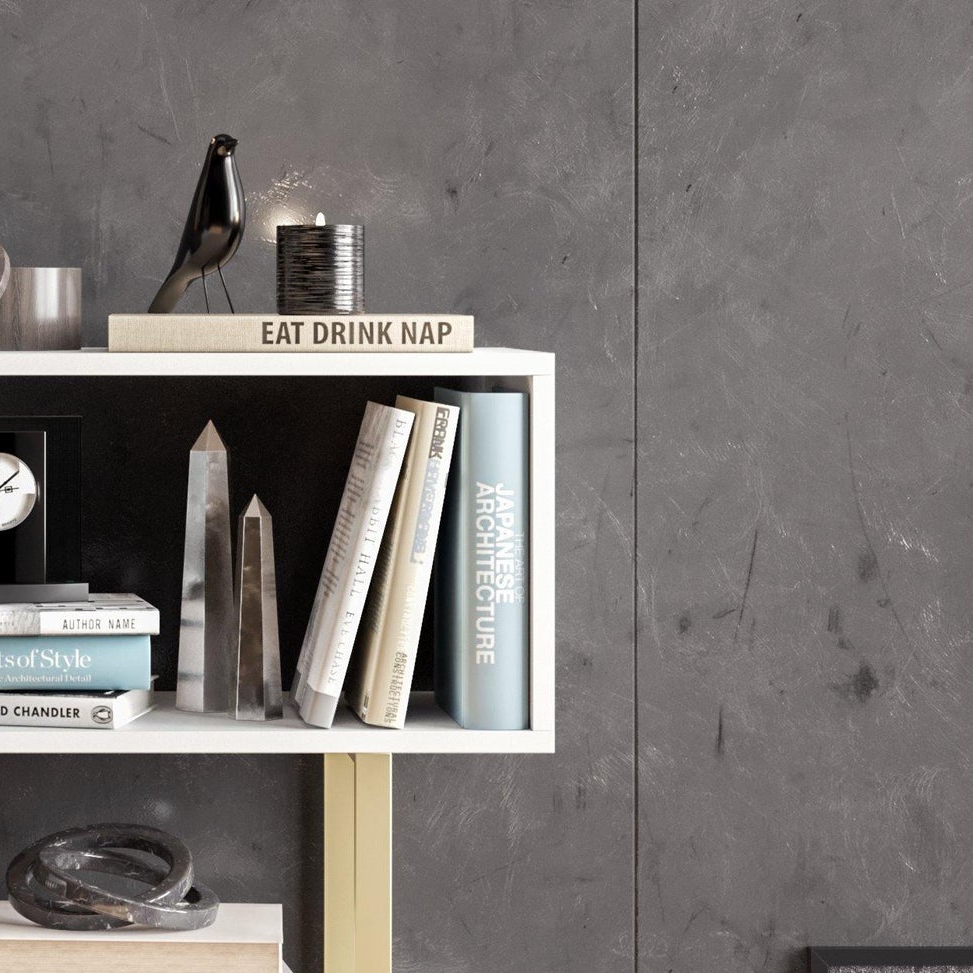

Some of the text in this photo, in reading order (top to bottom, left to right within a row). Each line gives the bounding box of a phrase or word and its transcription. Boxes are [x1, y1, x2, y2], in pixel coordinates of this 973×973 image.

[261, 321, 452, 345] EAT DRINK NAP
[495, 483, 515, 604] JAPANESE
[349, 553, 371, 597] HALL
[476, 481, 495, 664] ARCHITECTURE
[515, 532, 525, 603] THE ART OF
[63, 618, 102, 630] AUTHOR
[108, 618, 136, 630] NAME
[17, 648, 39, 668] of
[40, 648, 92, 672] Style
[4, 673, 63, 682] Architectural
[65, 673, 92, 682] Detail
[388, 652, 408, 723] ARCHITECTURAL
[13, 705, 81, 719] CHANDLER
